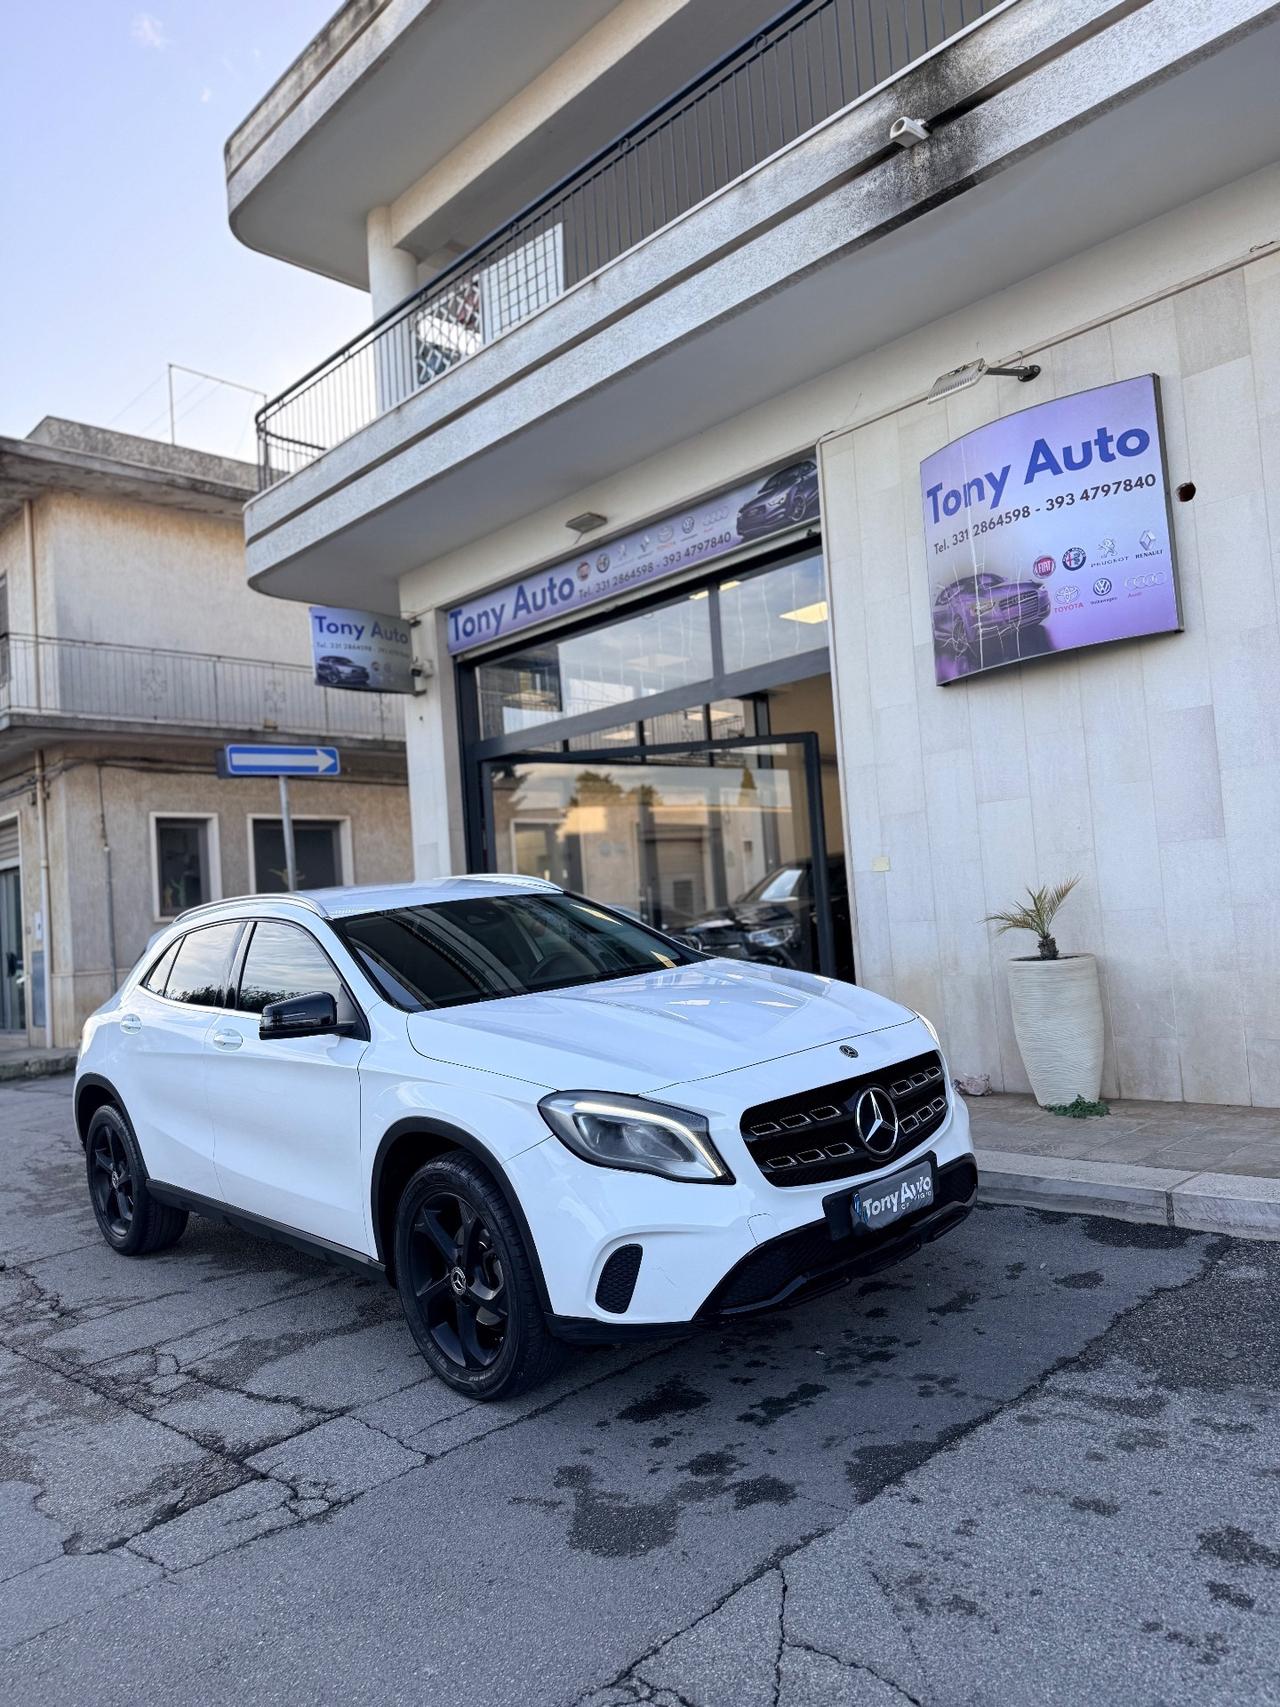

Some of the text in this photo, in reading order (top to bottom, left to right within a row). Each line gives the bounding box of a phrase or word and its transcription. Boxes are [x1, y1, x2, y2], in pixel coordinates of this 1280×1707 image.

[927, 426, 1150, 524] Tony Auto
[933, 538, 949, 554] Tel.
[952, 529, 970, 546] 331
[972, 505, 1031, 537] 2864598
[1046, 493, 1075, 512] 393
[1080, 473, 1156, 501] 4797840
[612, 562, 654, 587] 2864598
[663, 551, 682, 567] 393
[684, 532, 731, 557] 4797840
[1038, 561, 1053, 574] FIAT
[1135, 549, 1163, 559] RENAULT
[450, 576, 575, 641] Tony Auto
[1054, 602, 1084, 614] TOYOTA
[315, 615, 408, 644] Tony Auto
